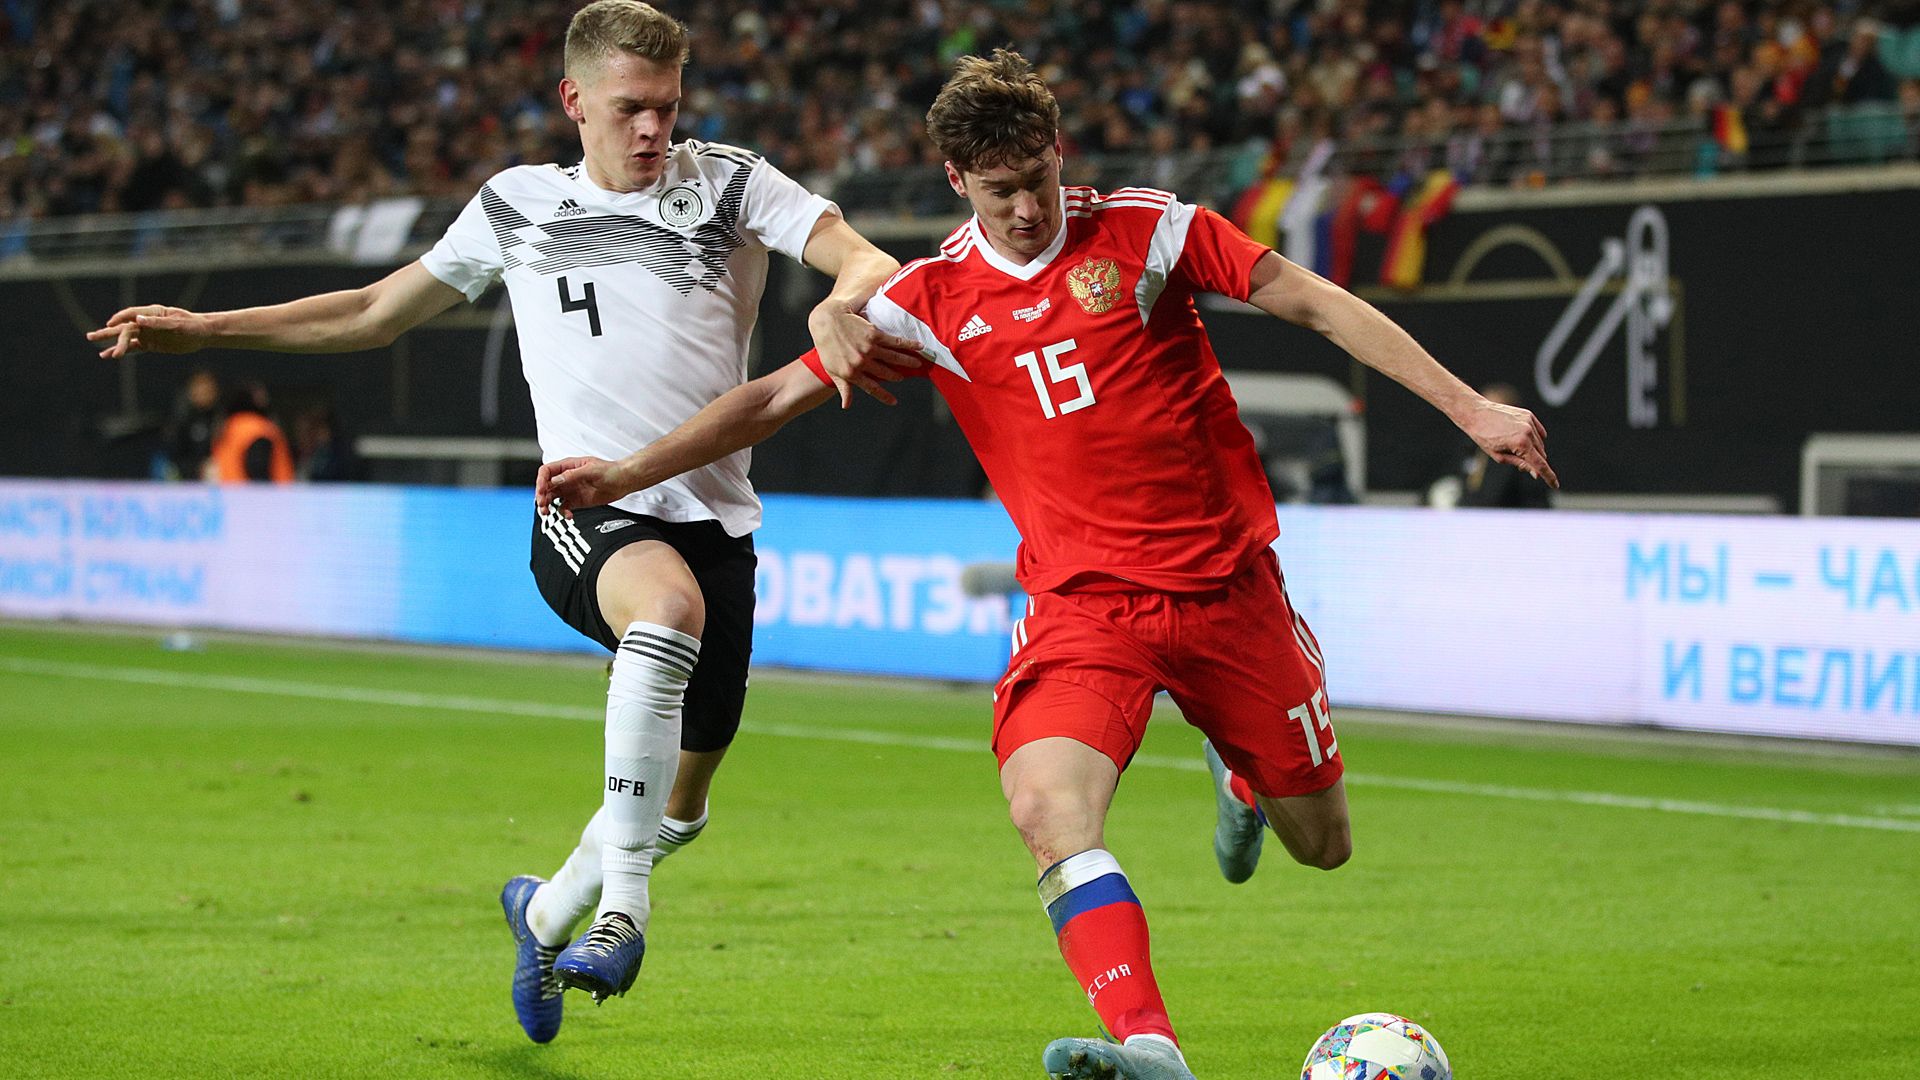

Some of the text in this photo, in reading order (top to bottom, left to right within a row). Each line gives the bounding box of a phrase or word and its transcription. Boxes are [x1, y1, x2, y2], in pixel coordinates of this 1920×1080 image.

[553, 206, 587, 218] adidas
[556, 275, 603, 338] 4
[957, 324, 993, 342] adidas
[1013, 337, 1097, 420] 15
[1624, 539, 1730, 605] МЫ
[1817, 543, 1920, 613] ЧА
[1661, 638, 1920, 716] И ВЕЛИ
[1287, 686, 1338, 768] 15
[608, 776, 646, 797] DFB
[1087, 963, 1132, 1008] ССИЯ
